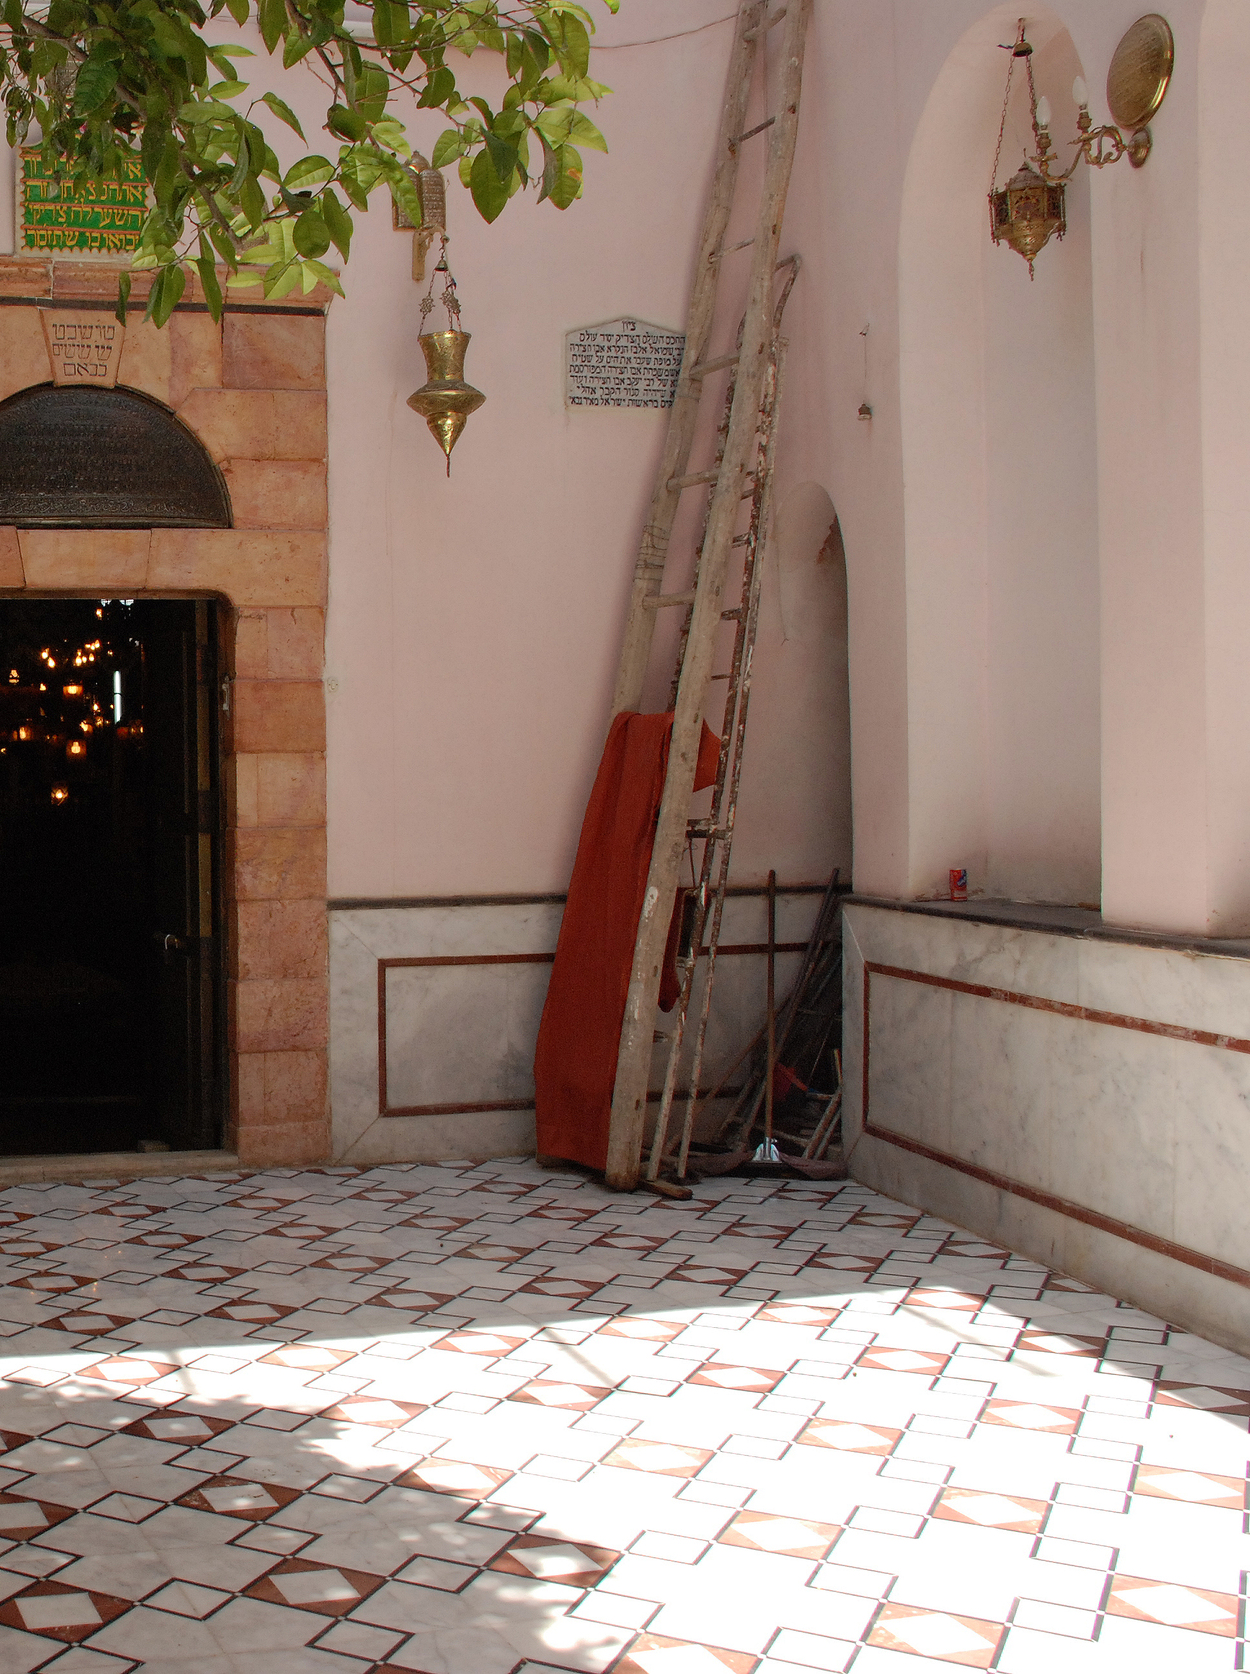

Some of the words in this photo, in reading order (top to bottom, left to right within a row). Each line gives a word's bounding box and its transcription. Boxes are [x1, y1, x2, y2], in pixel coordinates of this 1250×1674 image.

[94, 206, 142, 228] השער
[85, 231, 102, 248] בו
[103, 232, 140, 250] יבואו
[52, 323, 94, 341] שבט
[622, 320, 636, 332] ציון
[579, 330, 598, 342] עולם
[615, 333, 641, 346] הצדיק
[595, 352, 605, 364] על
[605, 355, 619, 364] הים
[643, 377, 655, 387] רבי
[656, 376, 669, 388] של
[600, 395, 626, 407] ישראל
